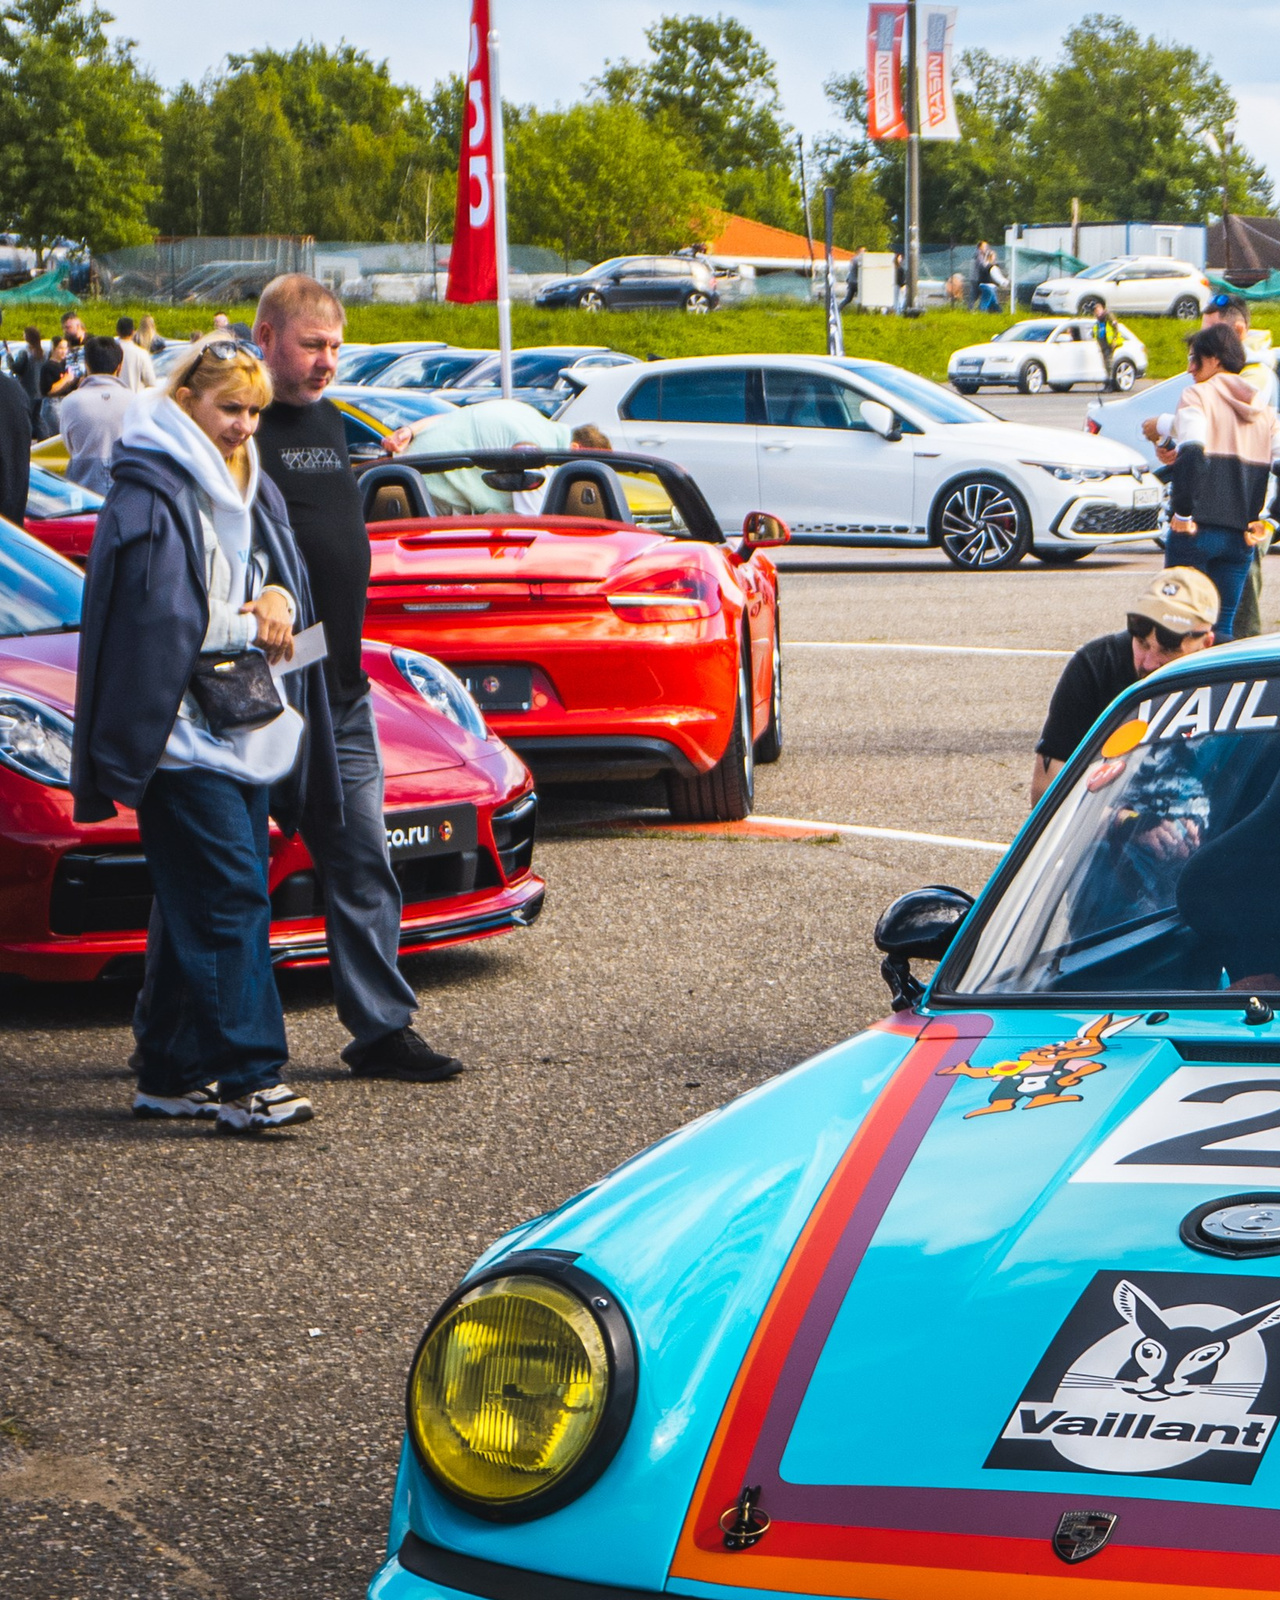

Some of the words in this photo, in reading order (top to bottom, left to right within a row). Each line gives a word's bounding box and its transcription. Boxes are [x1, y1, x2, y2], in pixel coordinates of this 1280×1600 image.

[878, 55, 891, 121] VASIN
[928, 54, 945, 124] VASIN
[1019, 1409, 1267, 1448] Vaillant
